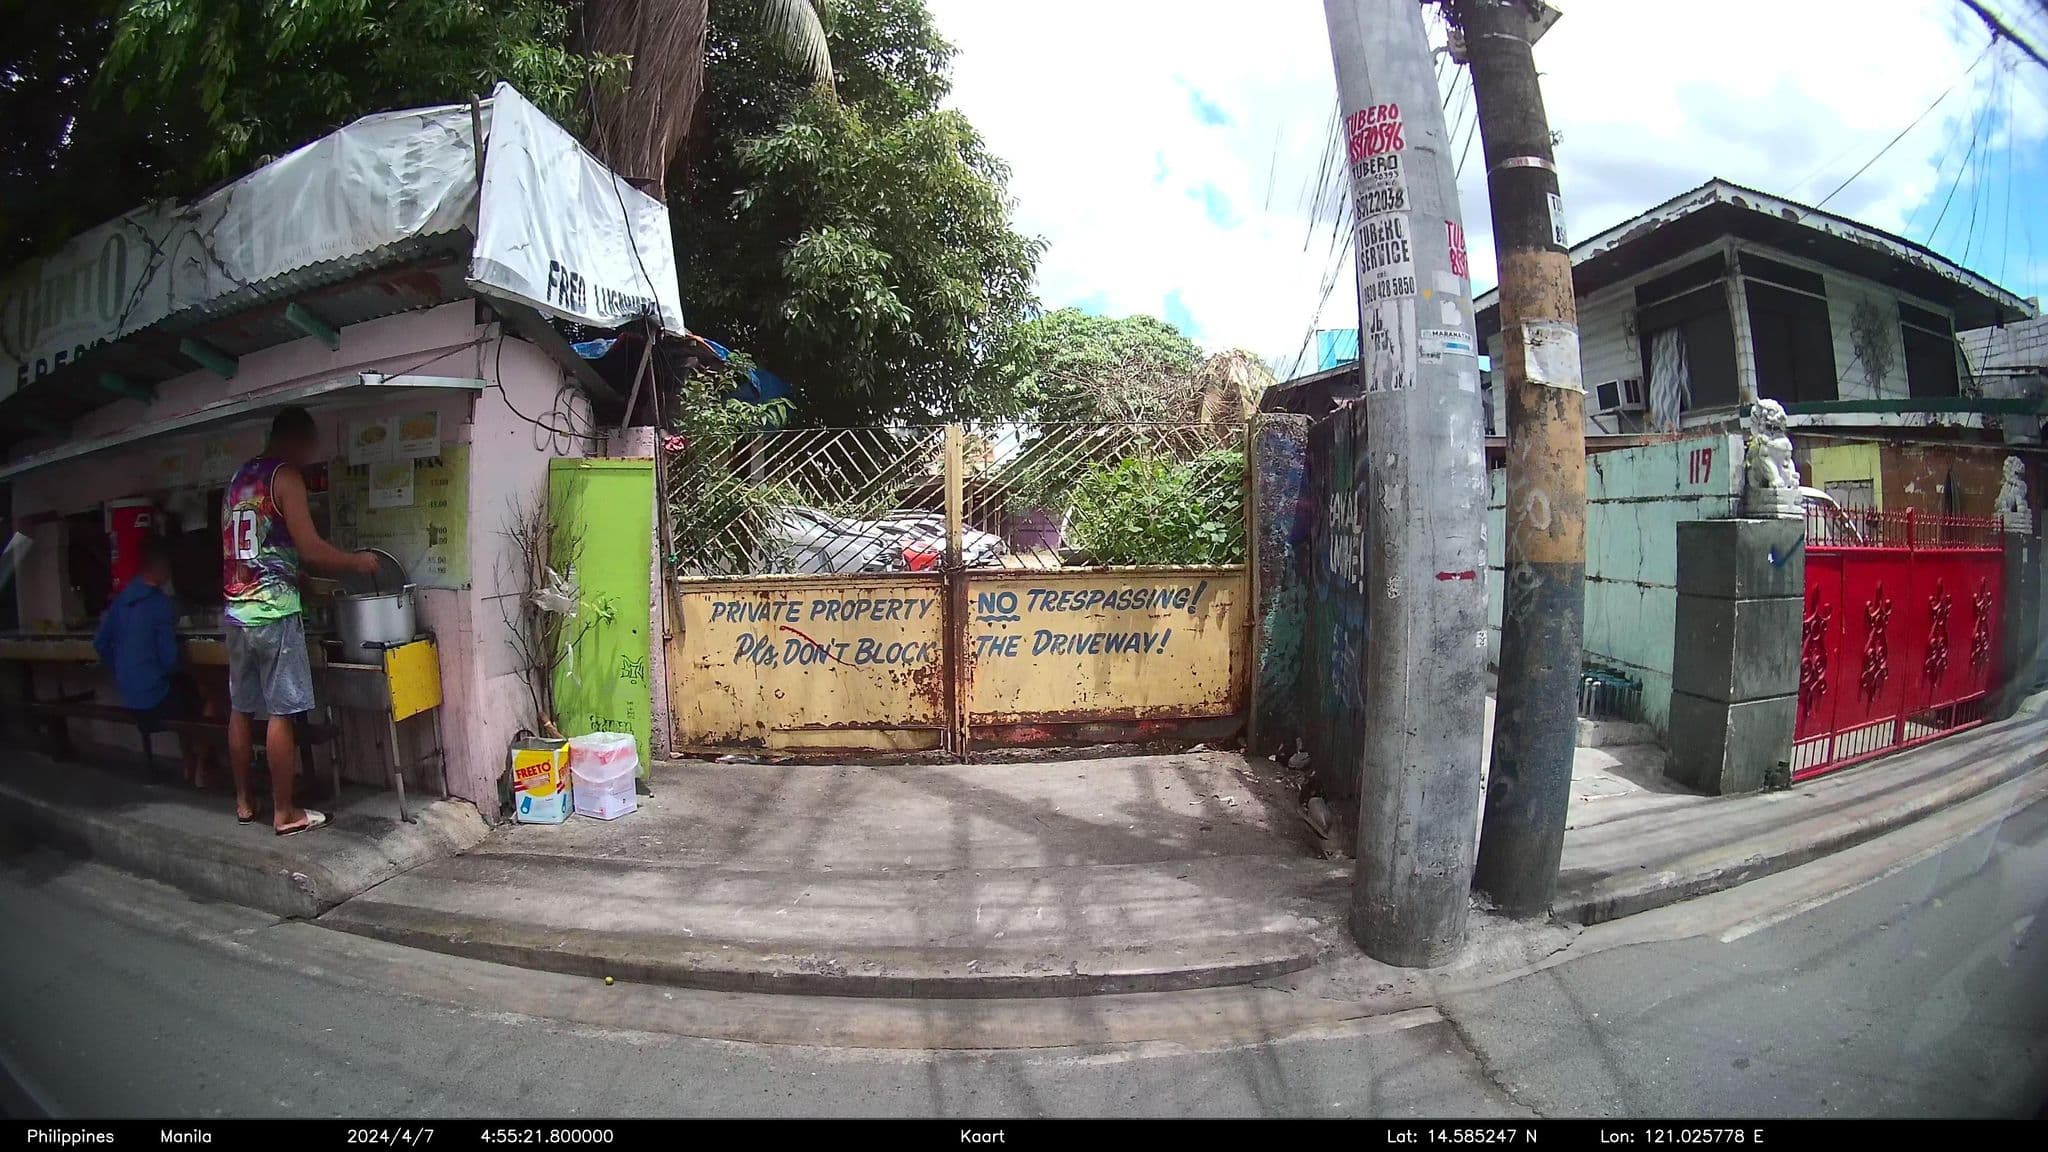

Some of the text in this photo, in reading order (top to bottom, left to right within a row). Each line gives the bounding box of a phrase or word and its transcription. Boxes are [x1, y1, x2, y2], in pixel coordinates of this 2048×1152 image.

[1346, 103, 1398, 138] TUBERO
[1352, 155, 1397, 179] TUBERO
[1359, 218, 1402, 250] TUBERO
[1361, 240, 1409, 274] SERVICE
[1393, 277, 1414, 296] 5850
[1690, 448, 1712, 484] 119
[233, 509, 259, 560] 13
[977, 580, 1208, 615] NO TRESPASSING!
[854, 637, 938, 665] BLOCK
[976, 628, 1172, 658] THE DRIVEWAY!
[515, 761, 551, 779] FREETO
